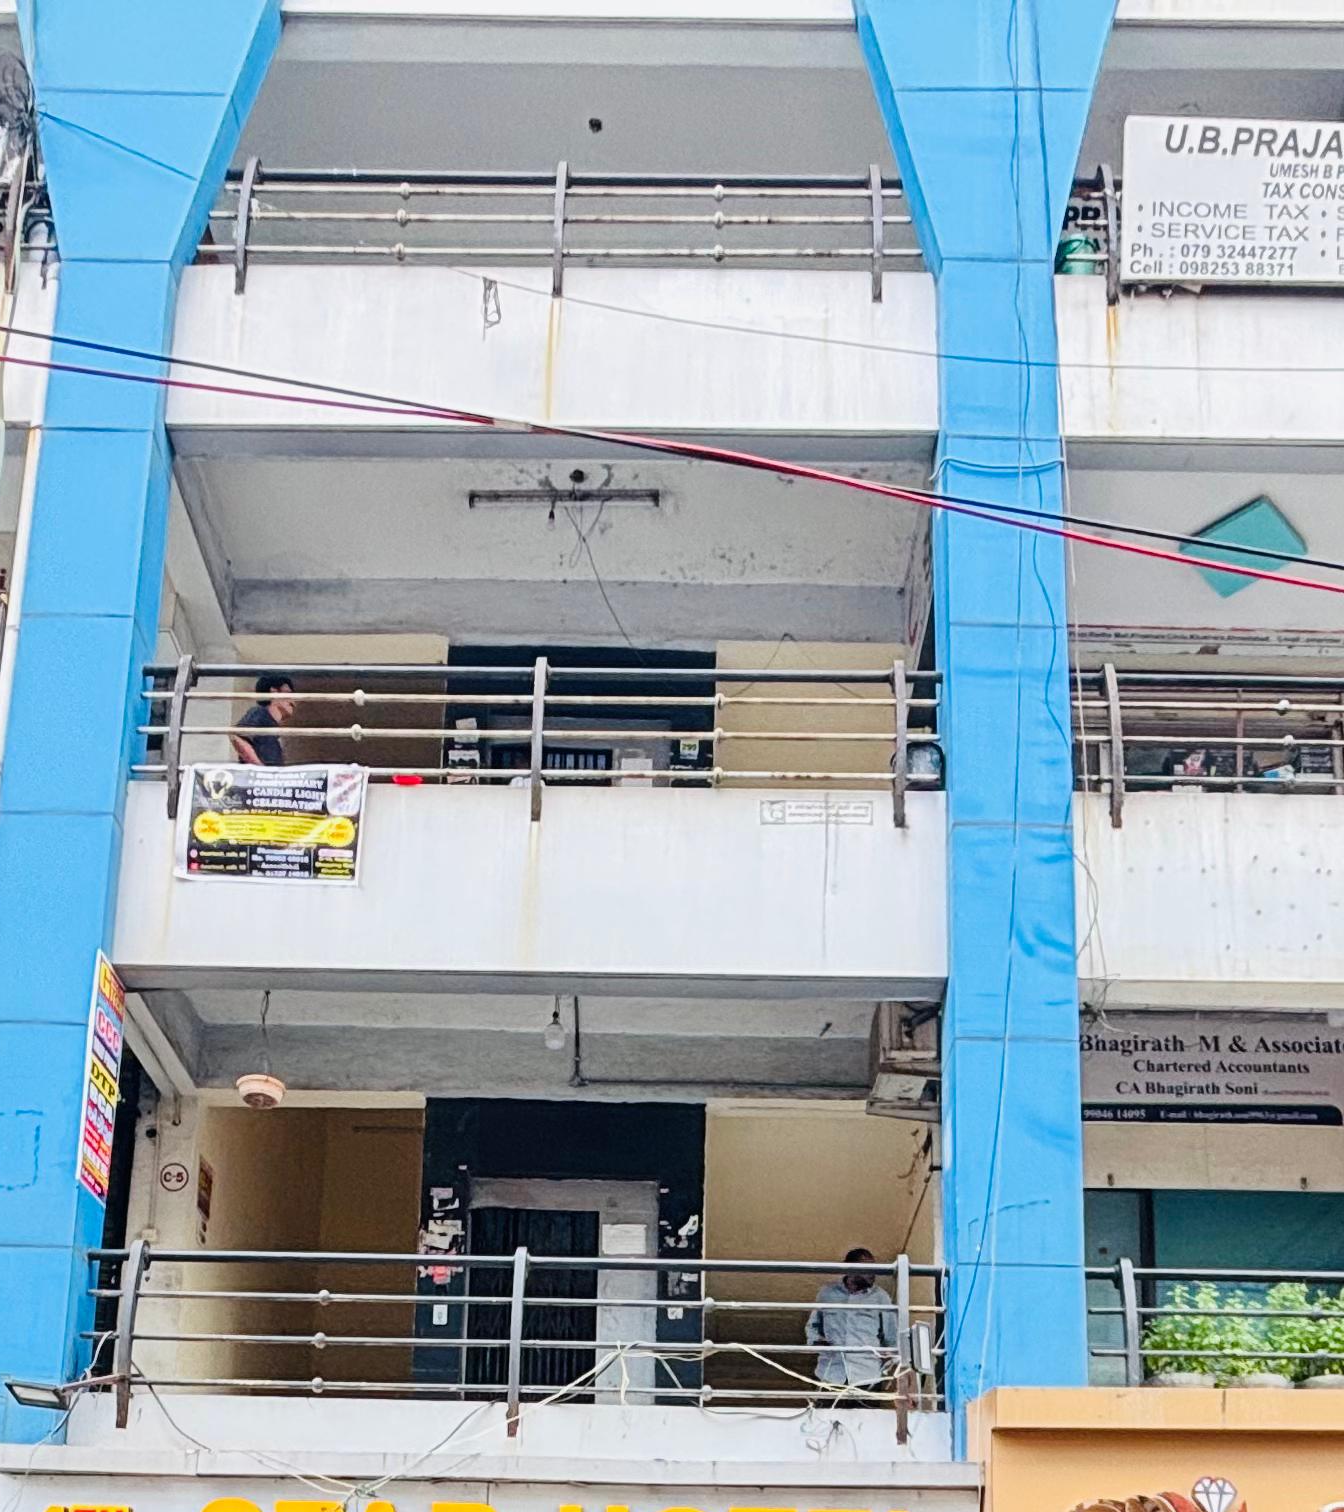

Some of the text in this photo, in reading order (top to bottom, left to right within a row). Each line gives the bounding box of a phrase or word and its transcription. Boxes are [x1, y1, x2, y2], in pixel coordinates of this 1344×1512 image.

[1270, 163, 1320, 179] UMESH
[1323, 165, 1334, 179] B
[1262, 182, 1296, 199] TAX
[1153, 202, 1309, 220] INCOME TAX
[1151, 223, 1309, 242] SERVICE TAX
[1180, 245, 1214, 260] 079
[1216, 245, 1298, 261] 32447277
[1179, 261, 1241, 276] 098253
[1244, 262, 1294, 277] 88371
[252, 788, 327, 801] CANDLE LIGHT
[252, 798, 324, 811] CELEBRATION
[1079, 1034, 1185, 1056] Bhagirath
[1199, 1035, 1221, 1052] M
[1228, 1036, 1248, 1053] &
[1133, 1059, 1311, 1075] Chartered Accountants
[90, 1060, 116, 1101] DTP
[1116, 1081, 1140, 1096] CA
[1145, 1081, 1220, 1098] Bhagirath
[1225, 1081, 1259, 1097] Soni
[163, 1171, 184, 1183] C-5
